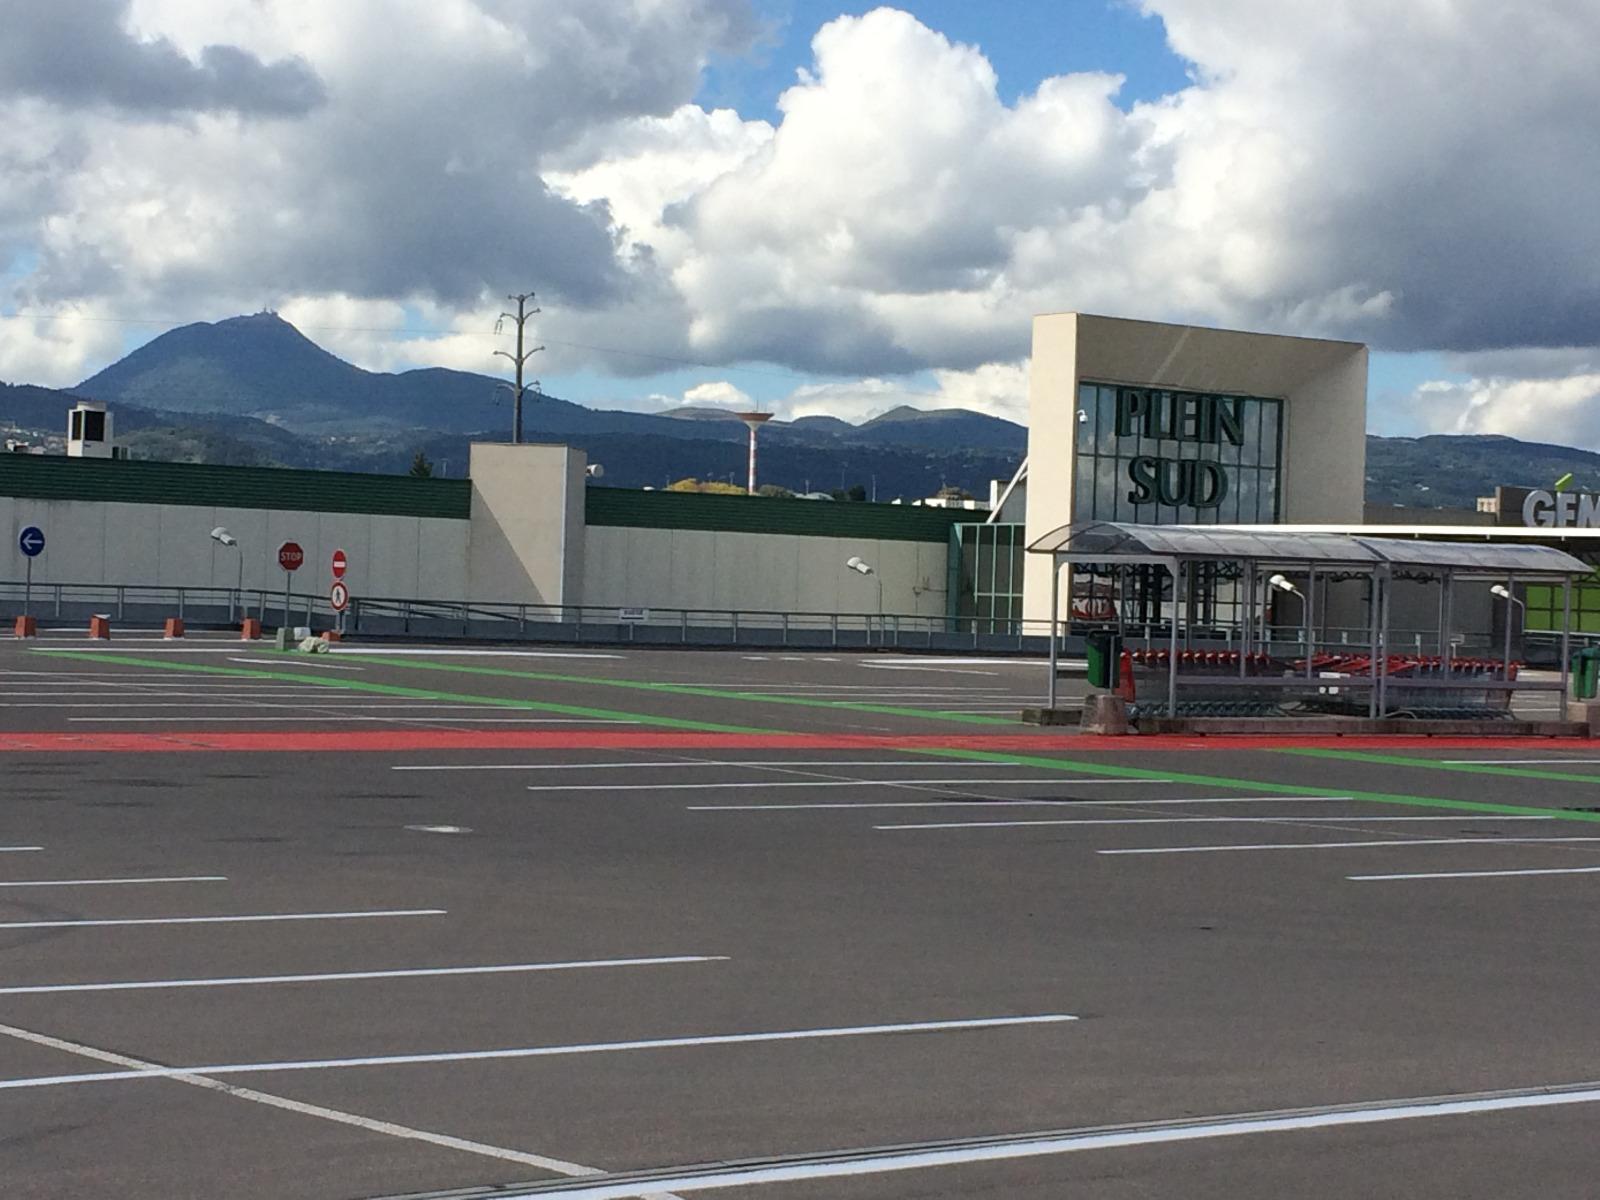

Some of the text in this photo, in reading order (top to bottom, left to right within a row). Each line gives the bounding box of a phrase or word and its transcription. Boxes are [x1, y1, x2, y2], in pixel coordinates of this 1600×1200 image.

[1115, 388, 1245, 446] PLEIN
[1128, 455, 1228, 508] SUD
[280, 551, 302, 561] STOP
